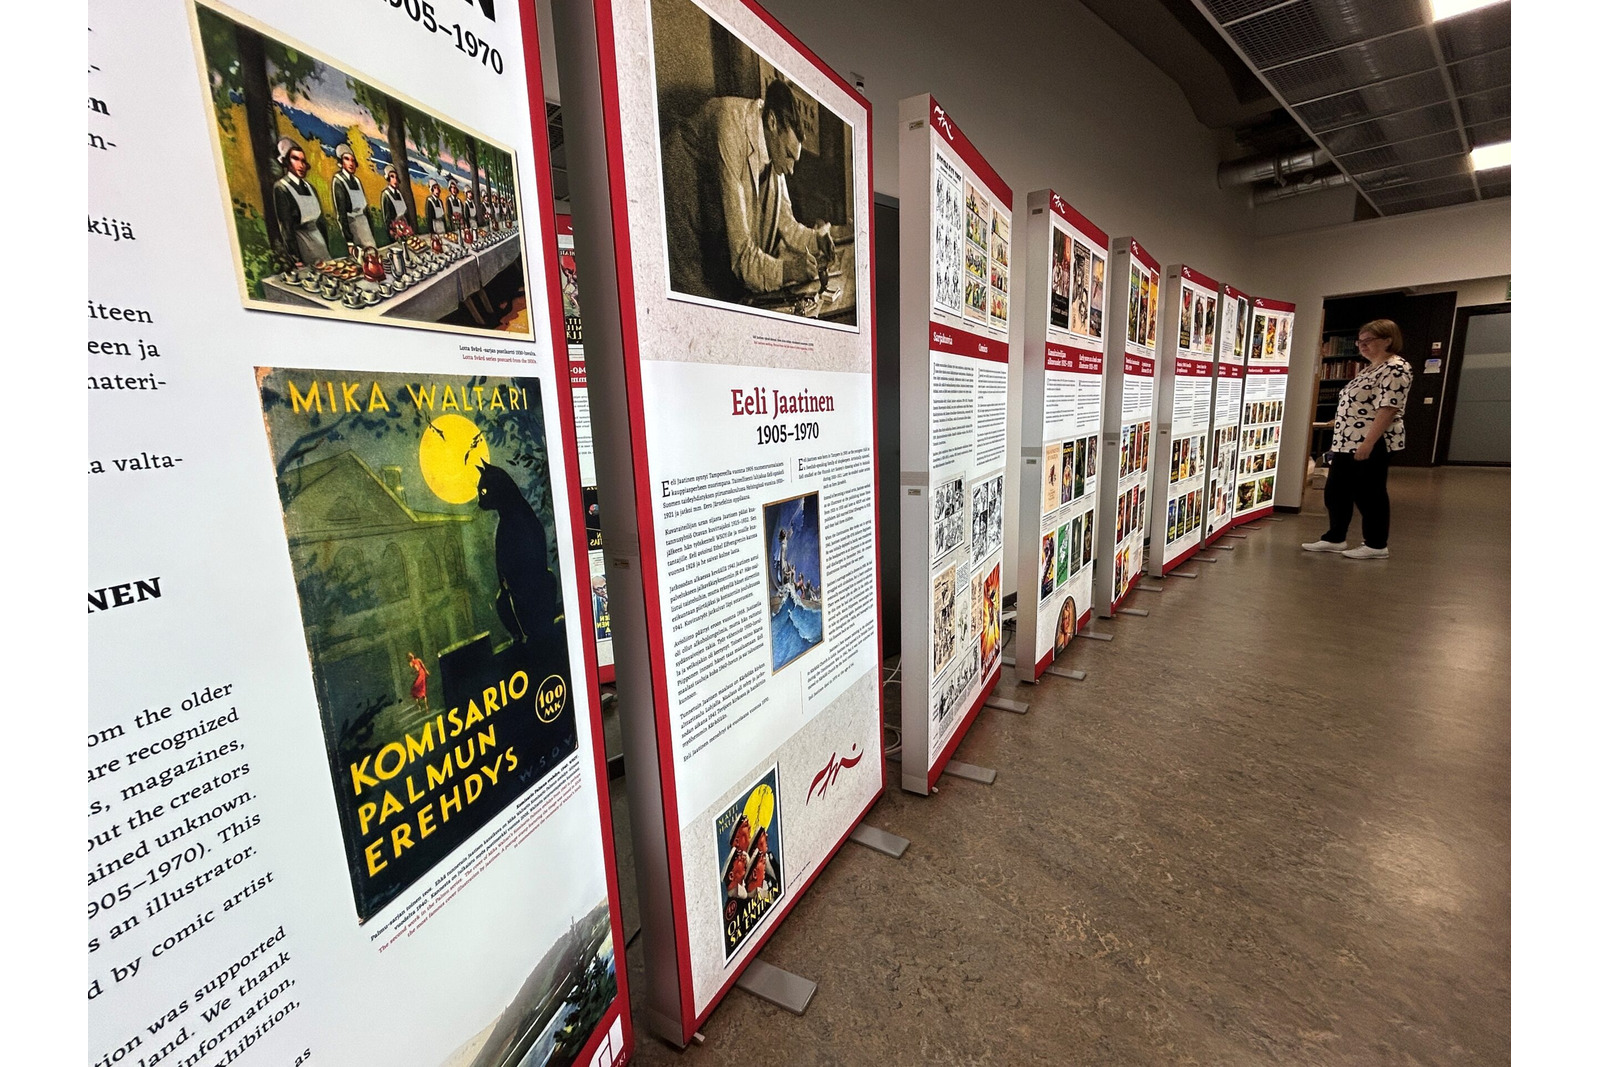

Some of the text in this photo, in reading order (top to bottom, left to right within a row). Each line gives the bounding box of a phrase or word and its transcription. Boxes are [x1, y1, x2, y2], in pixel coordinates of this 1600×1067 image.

[138, 340, 160, 360] ja
[288, 380, 528, 413] MIKA WALTARI
[731, 387, 834, 420] Eeli Jaatinen
[756, 422, 820, 445] 1905–1970
[113, 452, 182, 472] valta-
[709, 470, 731, 478] Tampereella
[671, 485, 706, 496] kauppiasperheen
[681, 493, 714, 504] taideyhdistyksen
[134, 706, 172, 729] the
[181, 684, 232, 711] older
[538, 684, 563, 709] 100
[544, 700, 562, 718] MK
[126, 707, 240, 766] recognized
[350, 670, 528, 796] KOMISARIO
[88, 741, 245, 817] s, magazines,
[128, 804, 165, 830] the
[170, 762, 250, 809] creators
[358, 724, 496, 836] PALMUN
[154, 791, 257, 848] unknown.
[217, 813, 261, 844] This
[364, 746, 518, 878] EREHDYS
[109, 916, 140, 940] an
[146, 844, 257, 918] illustrator.
[110, 956, 142, 984] by
[152, 908, 215, 958] comic
[222, 871, 274, 912] artist
[147, 926, 287, 1035] was supported
[200, 997, 232, 1025] We
[237, 951, 291, 997] thank
[214, 1001, 302, 1067] xhibition,
